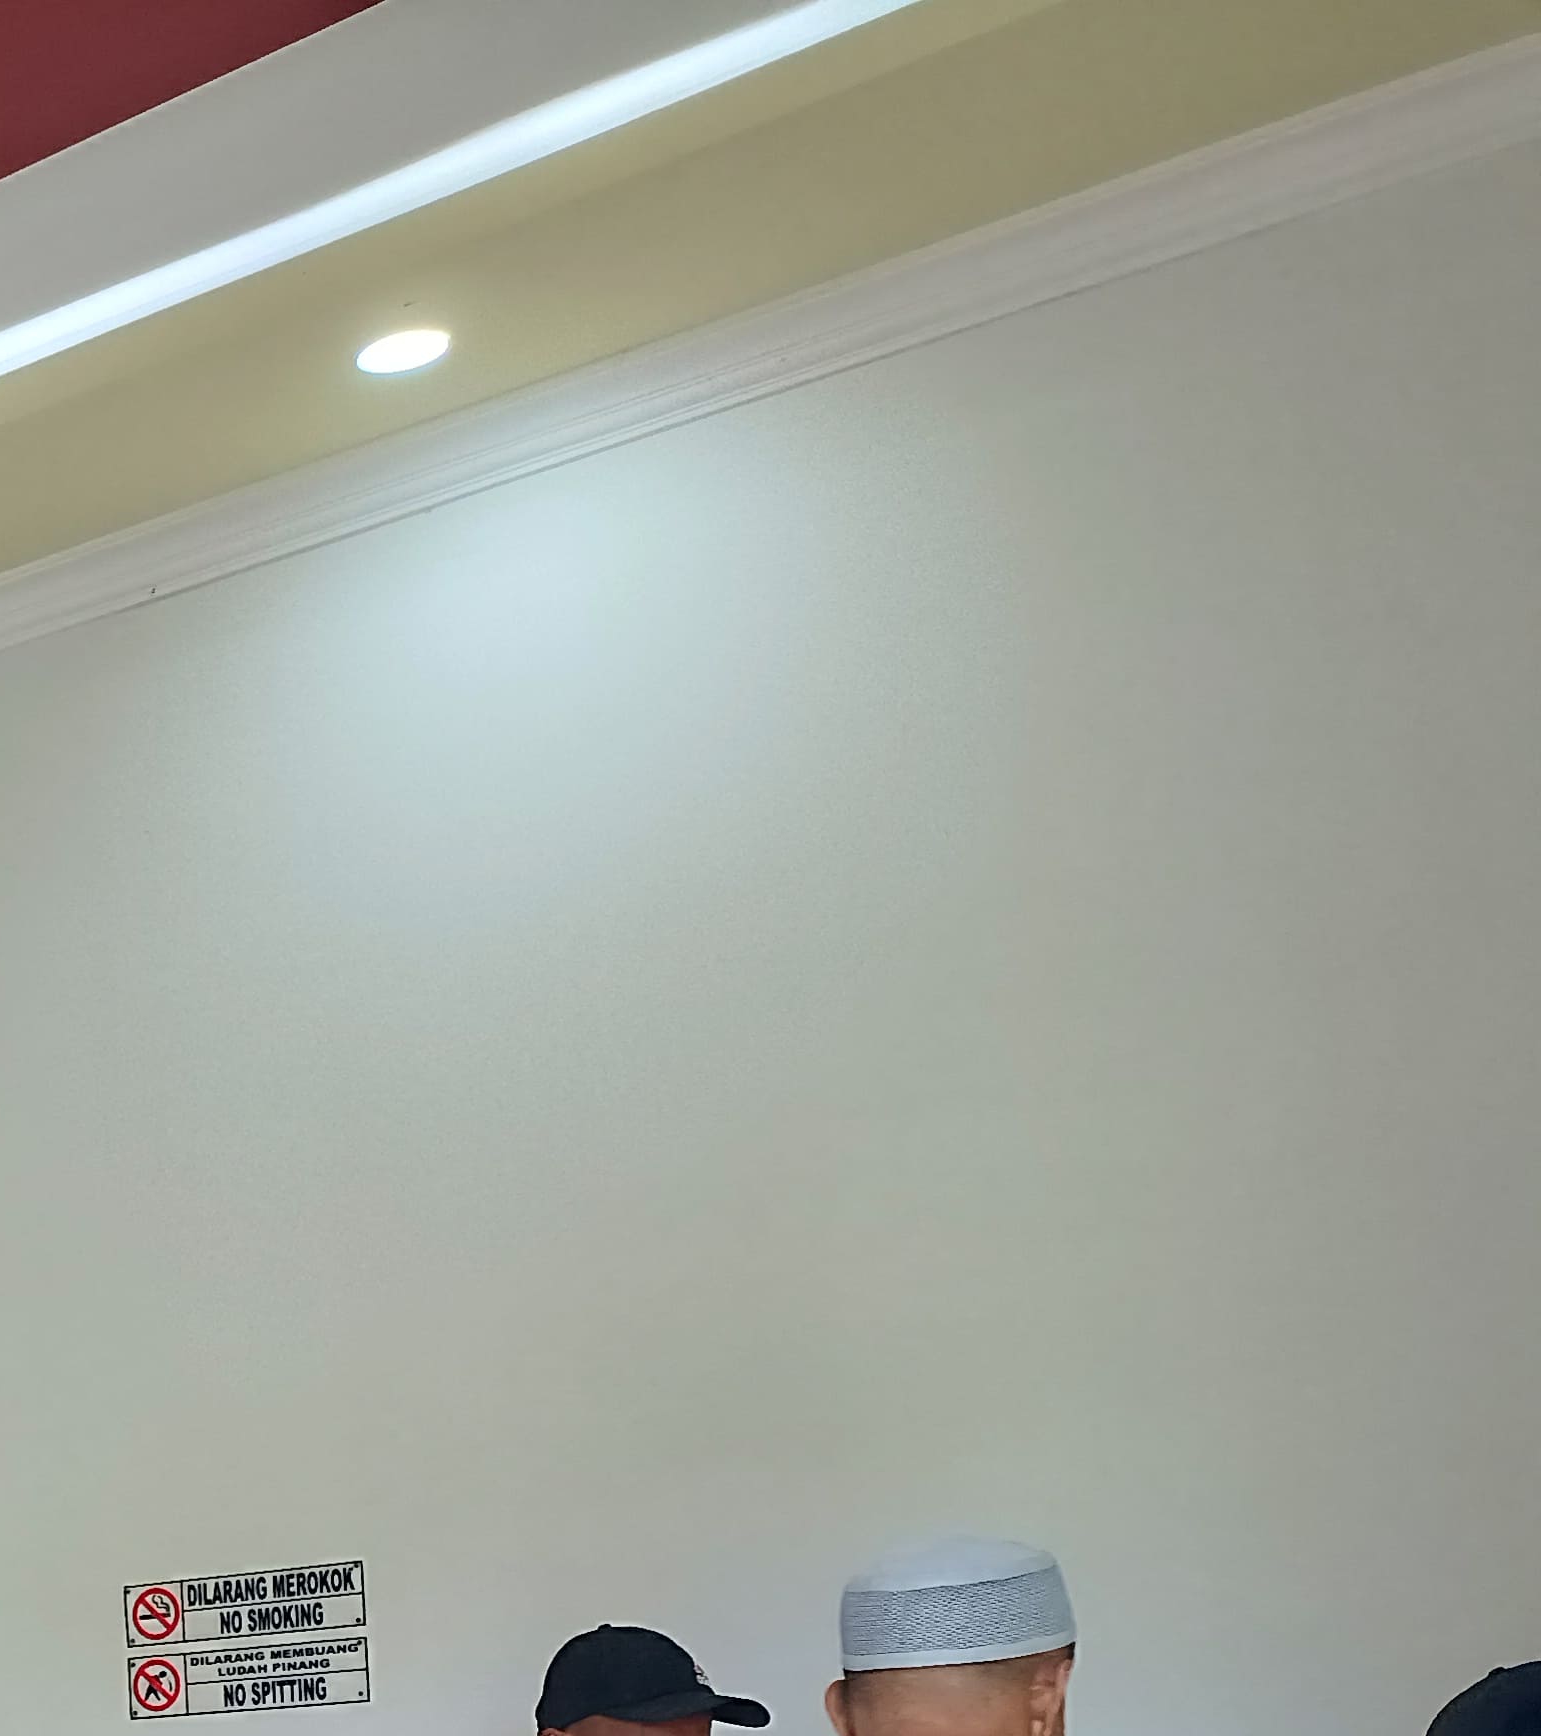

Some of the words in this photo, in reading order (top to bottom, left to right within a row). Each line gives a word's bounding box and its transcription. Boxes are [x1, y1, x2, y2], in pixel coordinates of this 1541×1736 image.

[187, 1579, 267, 1607] DILARANG
[273, 1567, 355, 1598] MEROKOK
[219, 1610, 242, 1635] NO
[247, 1602, 324, 1632] SMOKING
[190, 1651, 265, 1666] DILARANG
[270, 1644, 358, 1659] MEMBUANG
[218, 1664, 267, 1676] LUDAH
[272, 1659, 330, 1672] PINANG
[223, 1684, 246, 1707] NO
[251, 1677, 327, 1705] SPITTING
